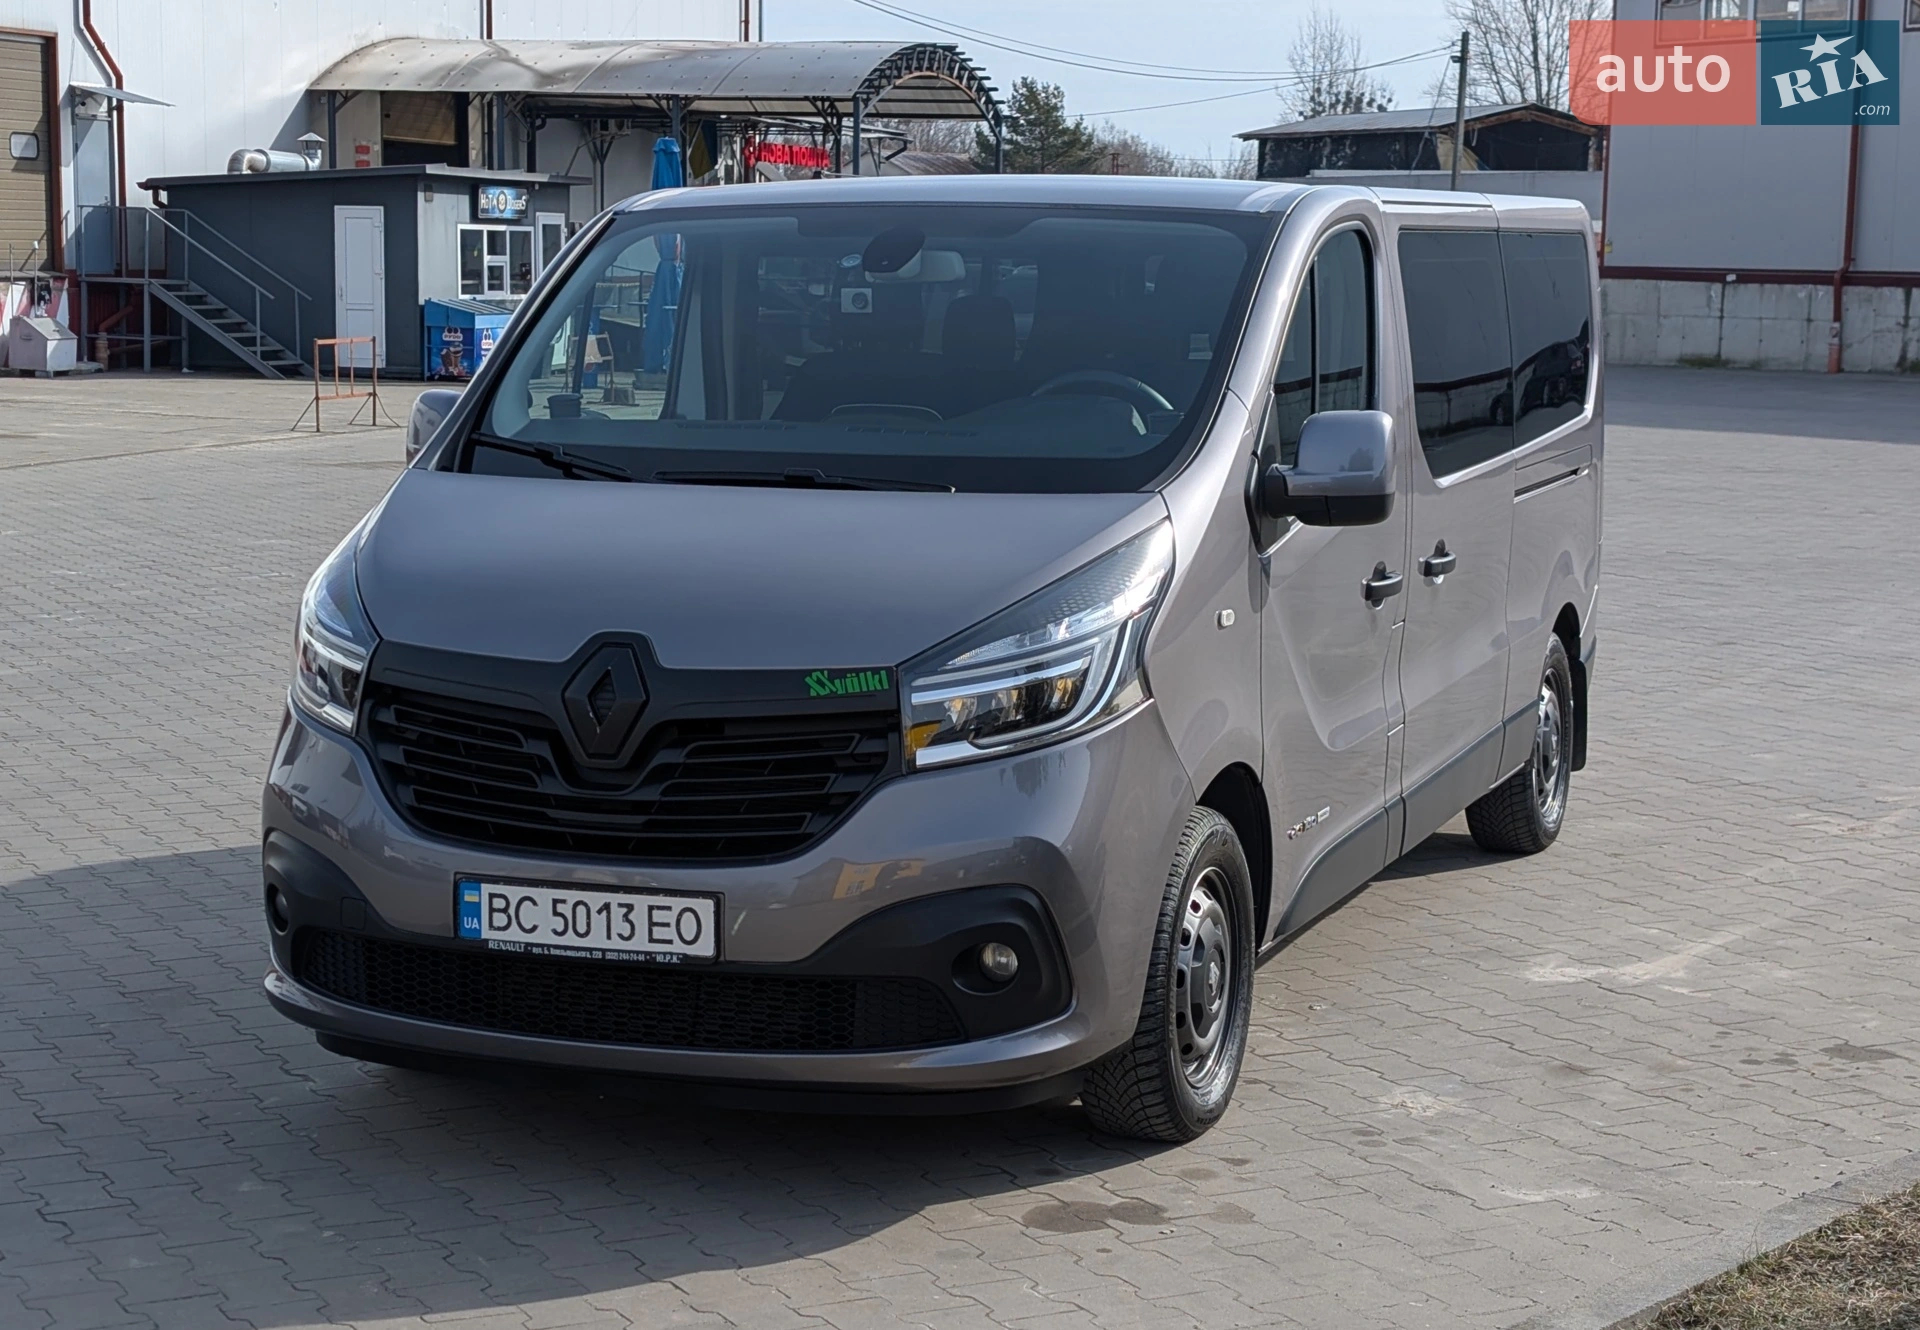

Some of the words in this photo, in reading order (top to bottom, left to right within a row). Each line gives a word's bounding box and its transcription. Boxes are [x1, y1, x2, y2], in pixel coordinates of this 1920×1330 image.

[761, 142, 790, 164] НОВА
[792, 145, 831, 168] ПОШТА
[463, 916, 480, 930] UA
[488, 892, 539, 935] BC
[550, 897, 636, 942] 5013
[647, 904, 703, 946] EO
[488, 939, 526, 952] RENAULT
